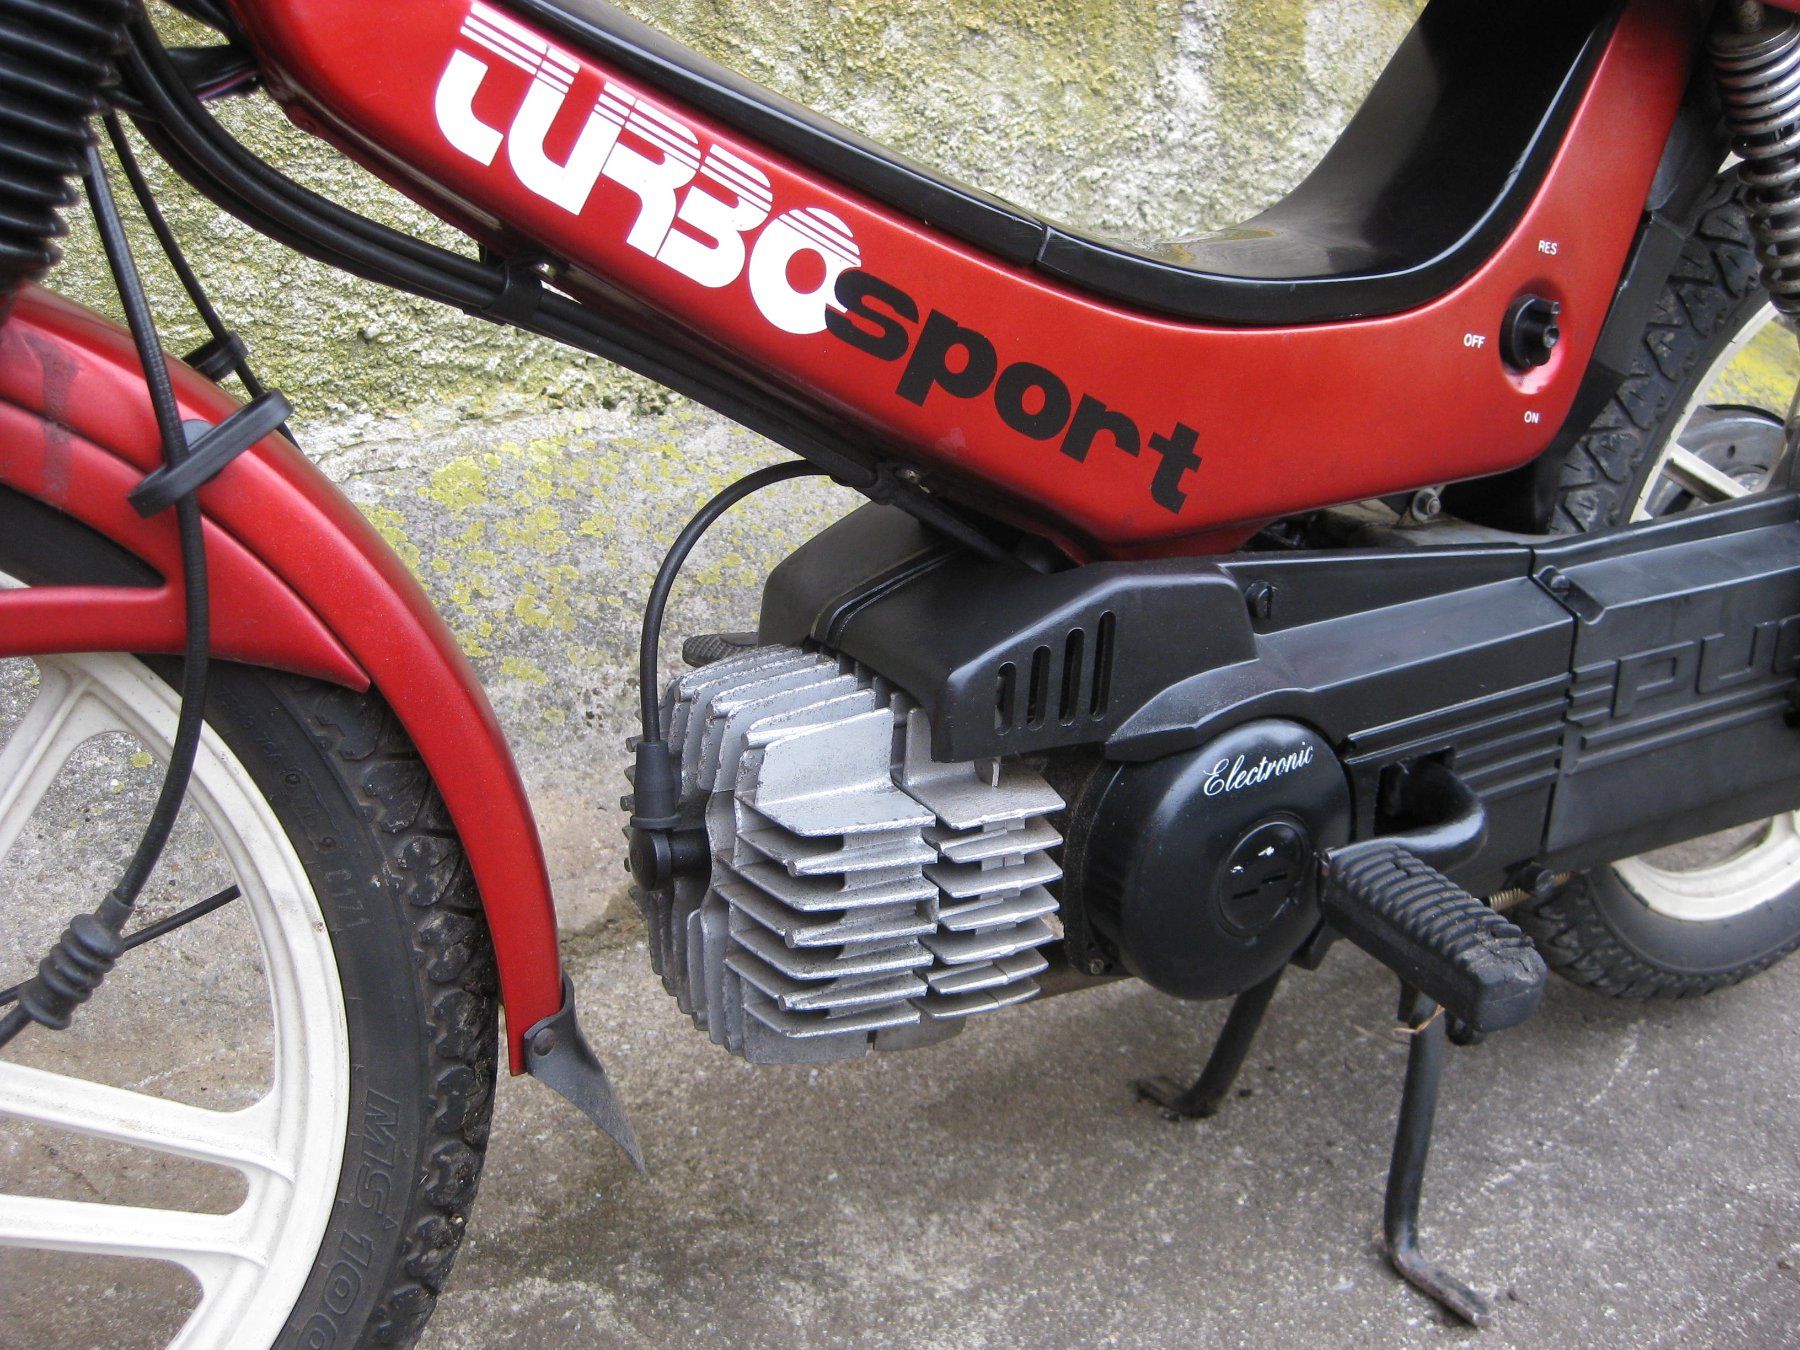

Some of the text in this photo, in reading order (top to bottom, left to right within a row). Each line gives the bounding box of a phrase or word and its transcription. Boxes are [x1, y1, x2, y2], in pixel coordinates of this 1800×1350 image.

[1538, 240, 1557, 255] RES
[435, 0, 1202, 514] TURBO sport
[1463, 333, 1485, 349] OFF
[1524, 410, 1539, 424] ON
[1203, 741, 1314, 796] Electronic
